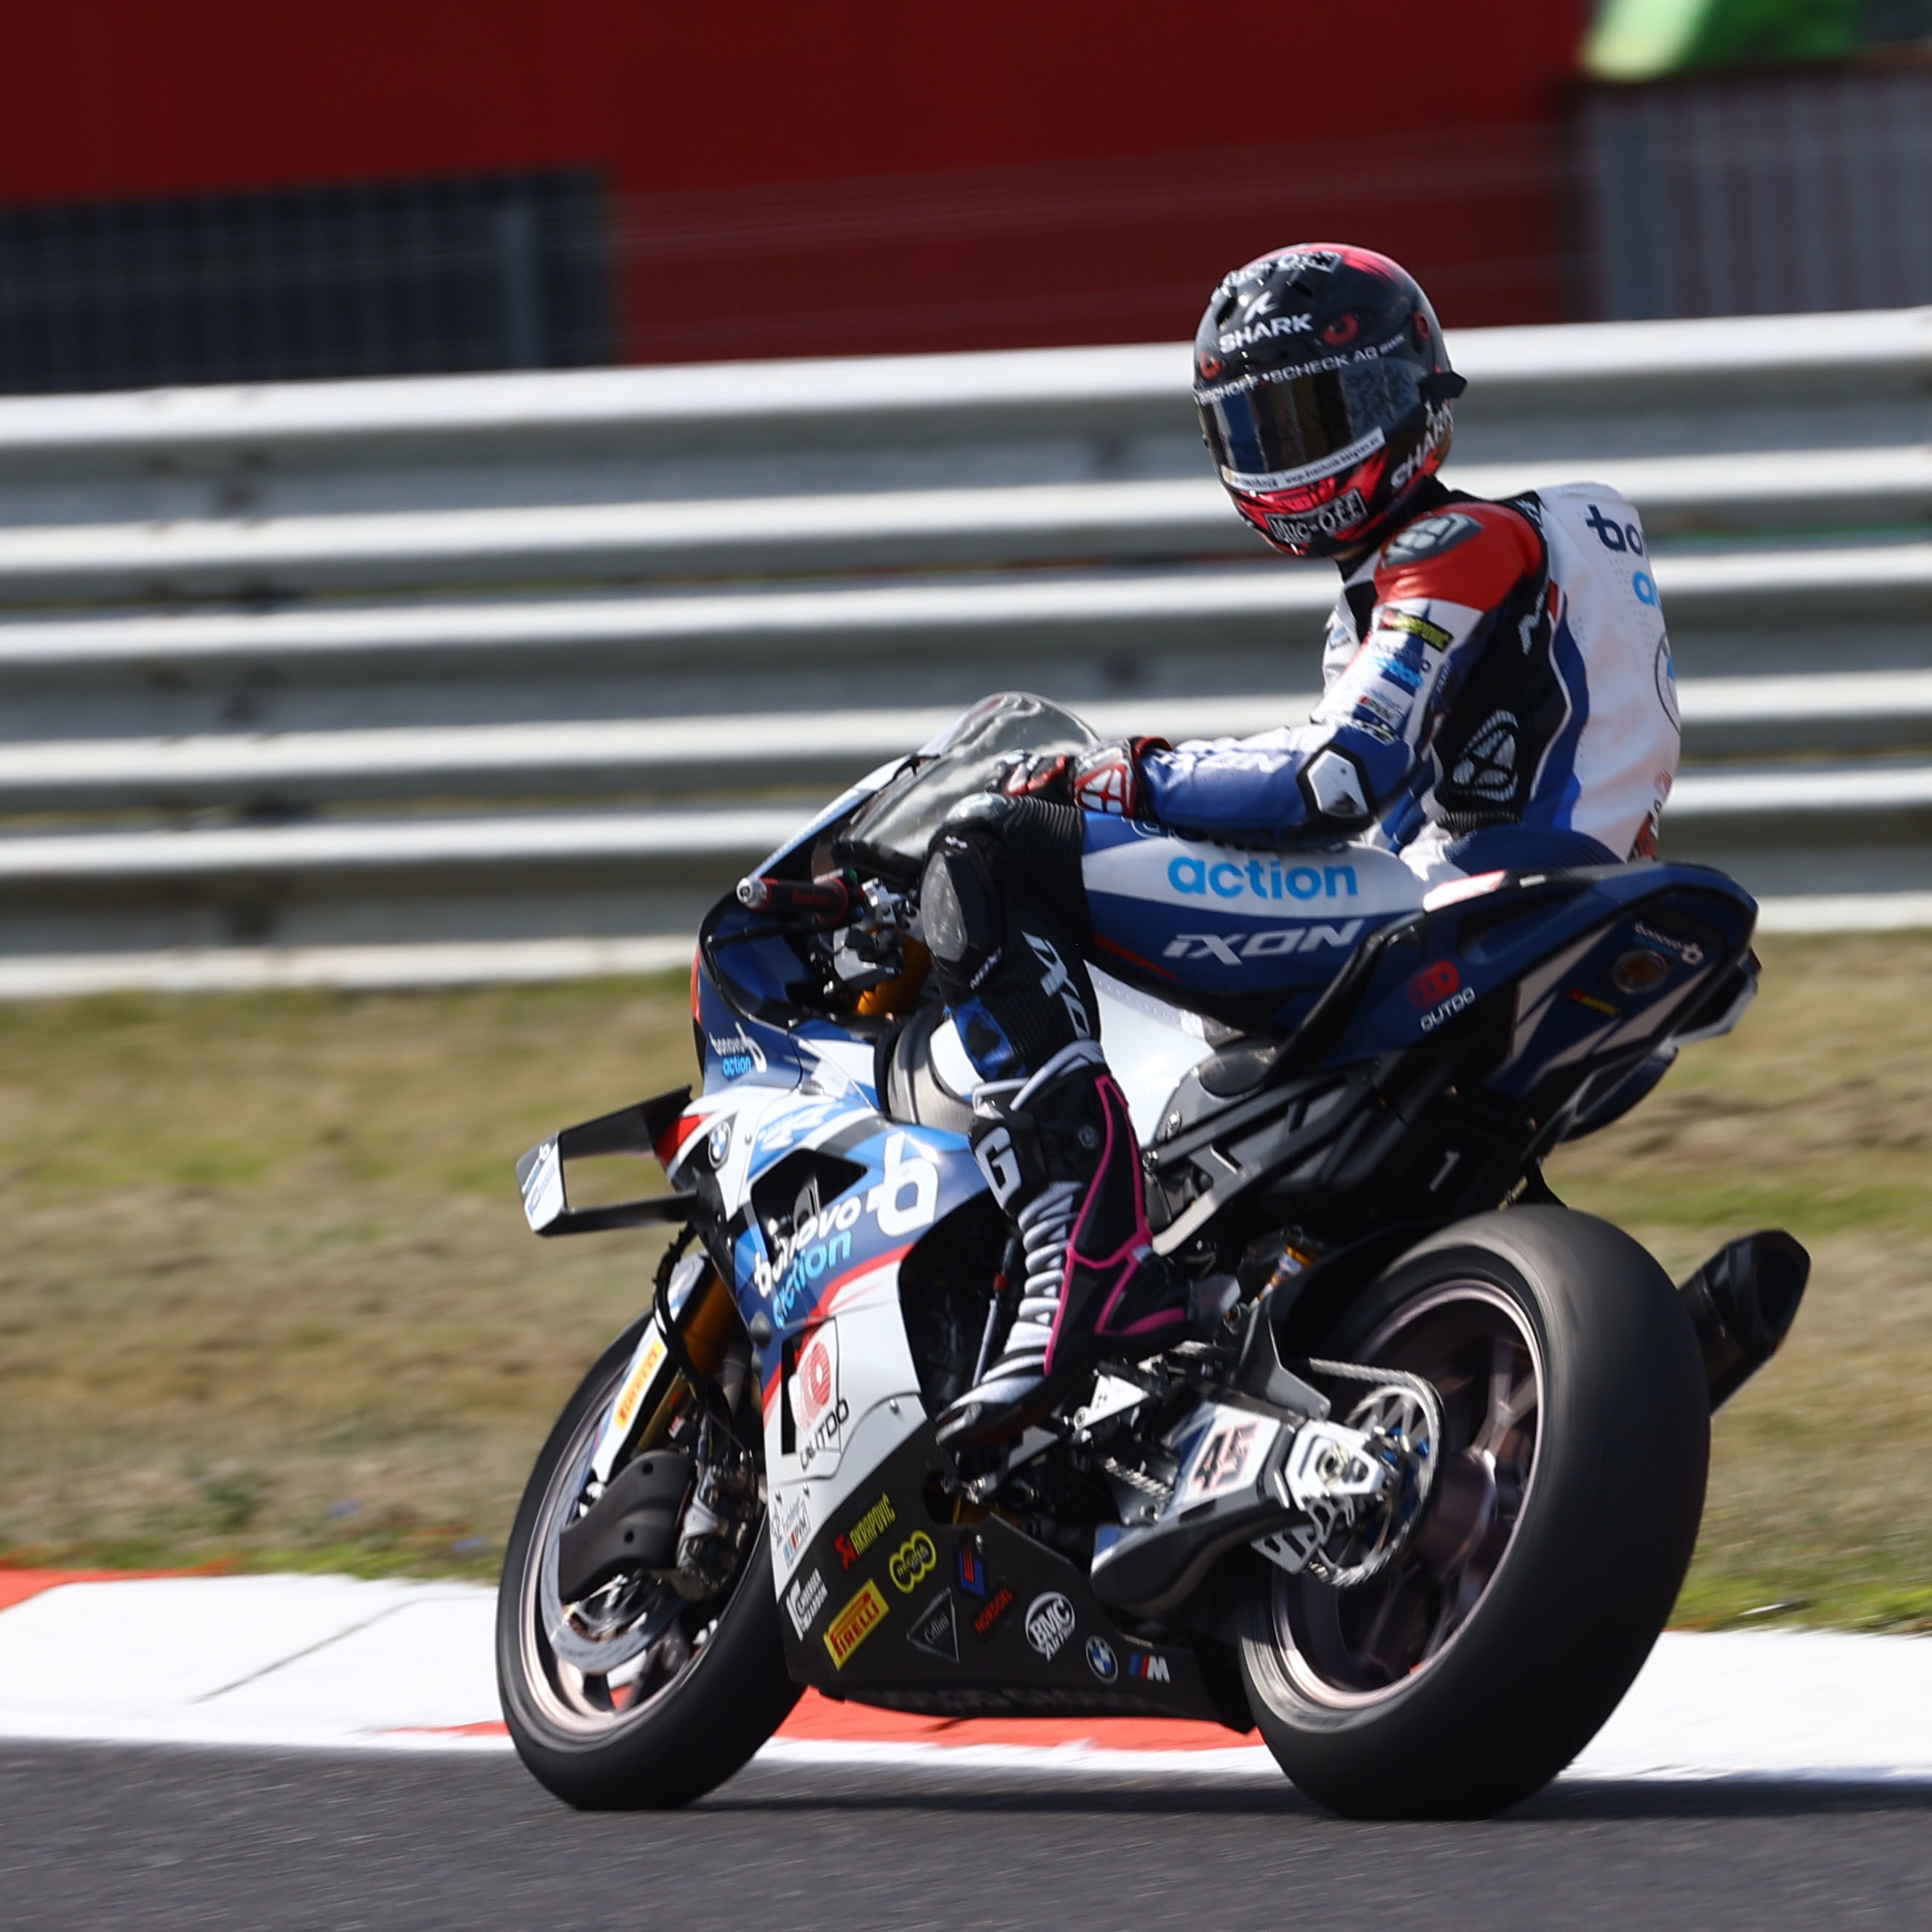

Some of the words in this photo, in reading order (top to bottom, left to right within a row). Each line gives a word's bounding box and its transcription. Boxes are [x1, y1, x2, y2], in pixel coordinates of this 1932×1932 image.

[1219, 313, 1313, 354] SHARK
[1168, 856, 1358, 900] action
[1421, 986, 1476, 1032] OUTDO
[723, 1054, 751, 1077] action
[773, 1230, 851, 1329] action
[829, 1591, 881, 1658] PIRELLI
[1029, 1598, 1070, 1649] BMC
